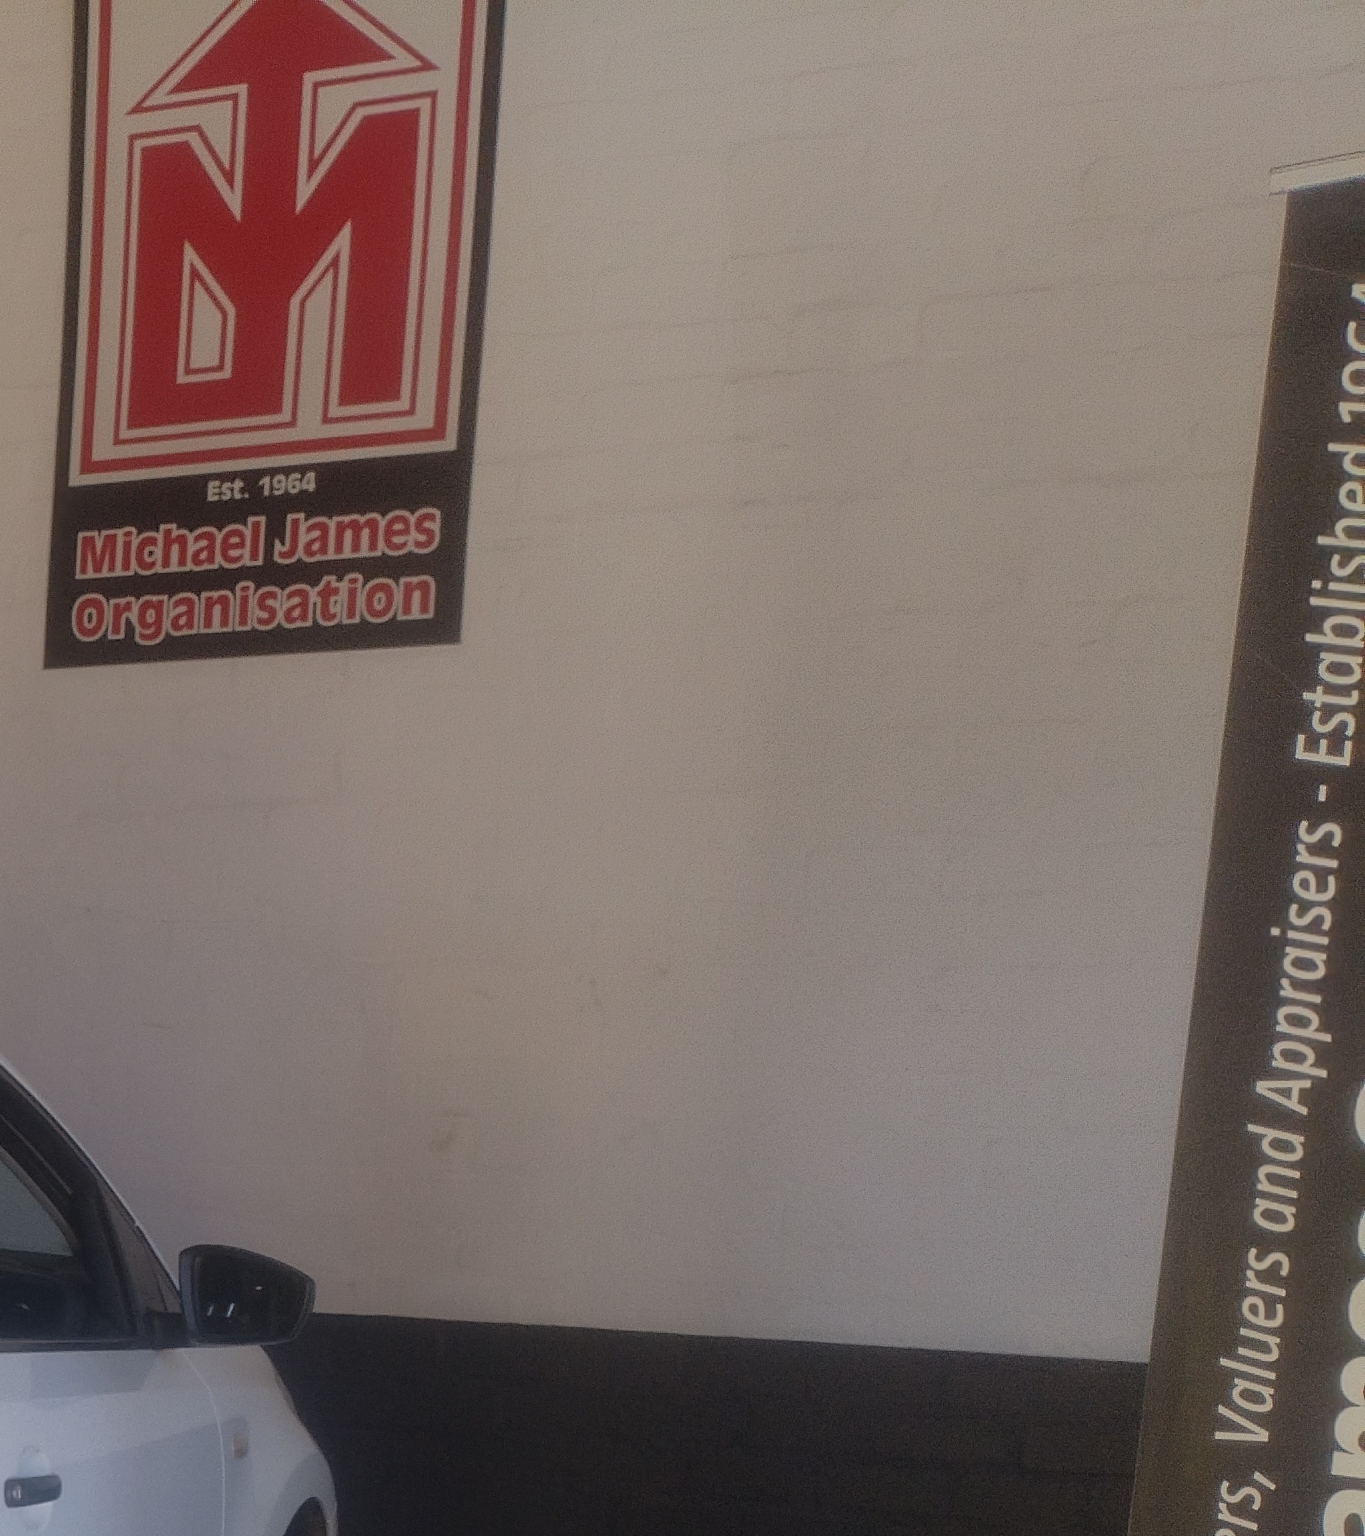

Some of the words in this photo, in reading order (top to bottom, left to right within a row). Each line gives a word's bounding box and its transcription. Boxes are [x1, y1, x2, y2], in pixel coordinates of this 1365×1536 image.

[206, 477, 250, 502] Est.
[258, 470, 317, 498] 1964
[75, 515, 266, 580] Michael
[273, 507, 442, 566] James
[71, 573, 437, 646] Organisation
[1254, 819, 1343, 1116] Appraisers
[1246, 1123, 1306, 1233] and
[1213, 1247, 1290, 1443] Valuers
